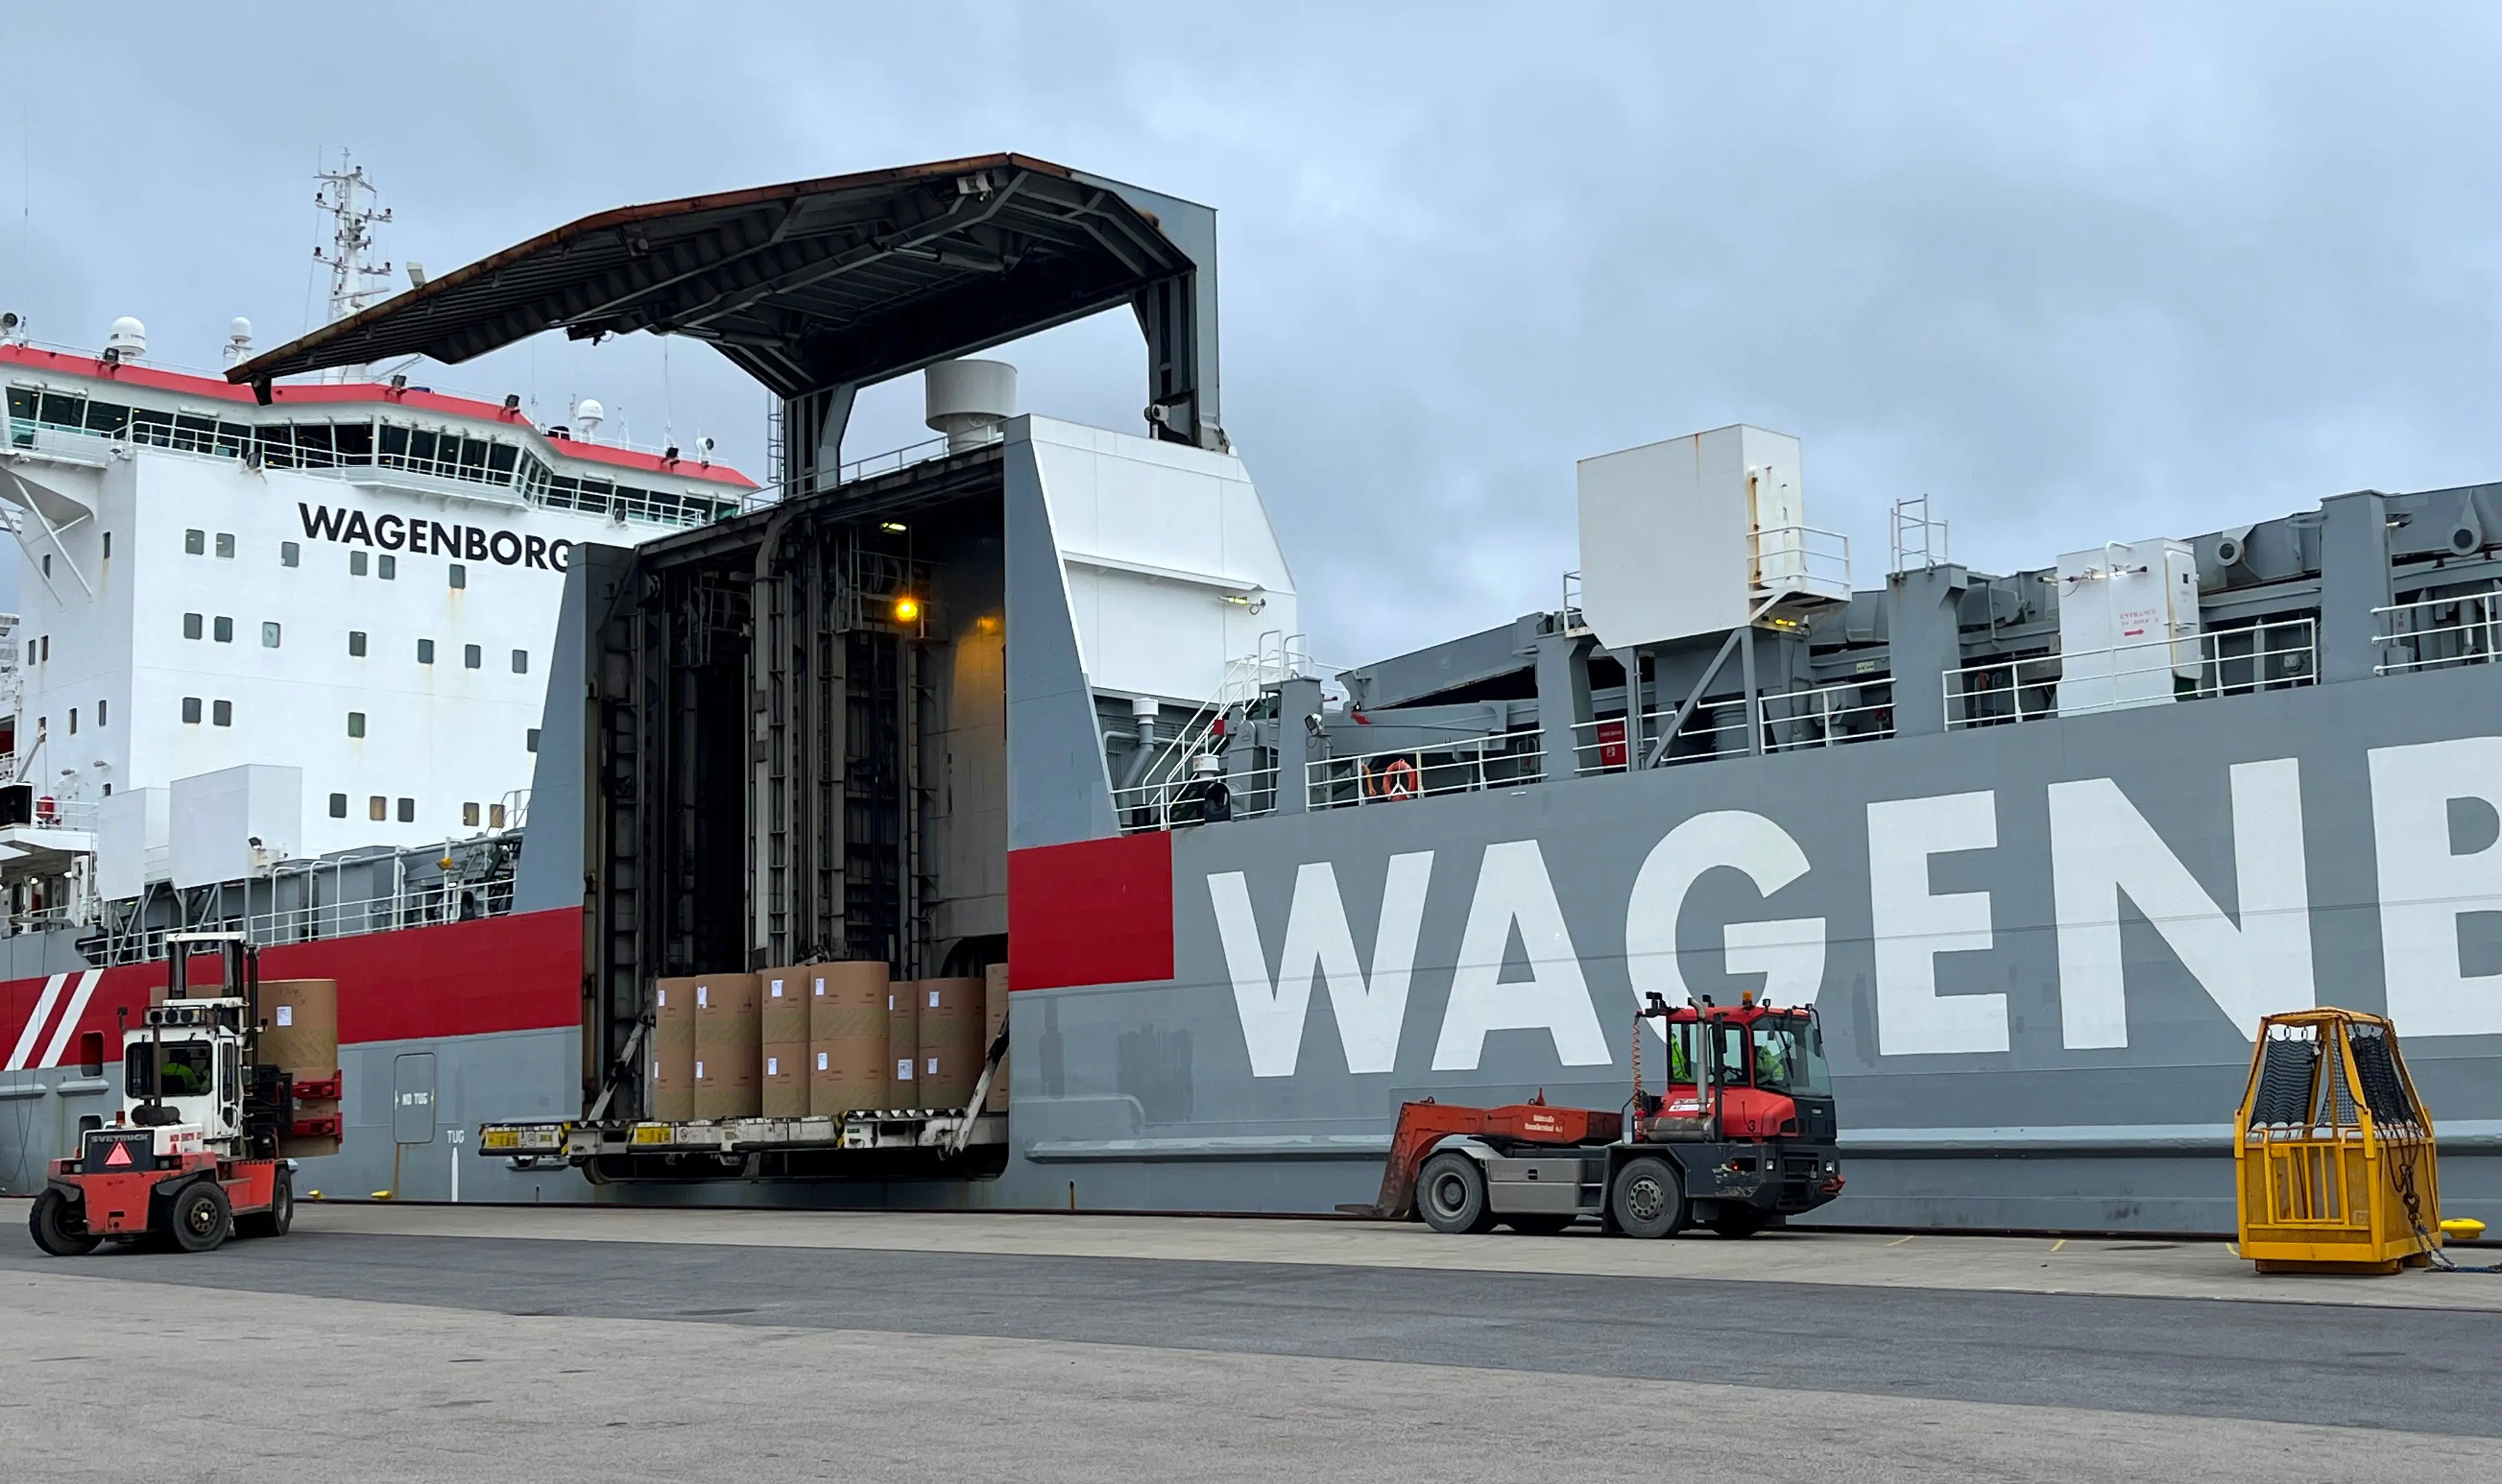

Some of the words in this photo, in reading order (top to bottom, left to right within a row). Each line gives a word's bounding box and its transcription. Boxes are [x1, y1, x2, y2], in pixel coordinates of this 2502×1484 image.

[298, 502, 574, 573] WAGENBORG
[90, 1133, 150, 1143] SVETRUCK
[447, 1129, 465, 1144] TUG
